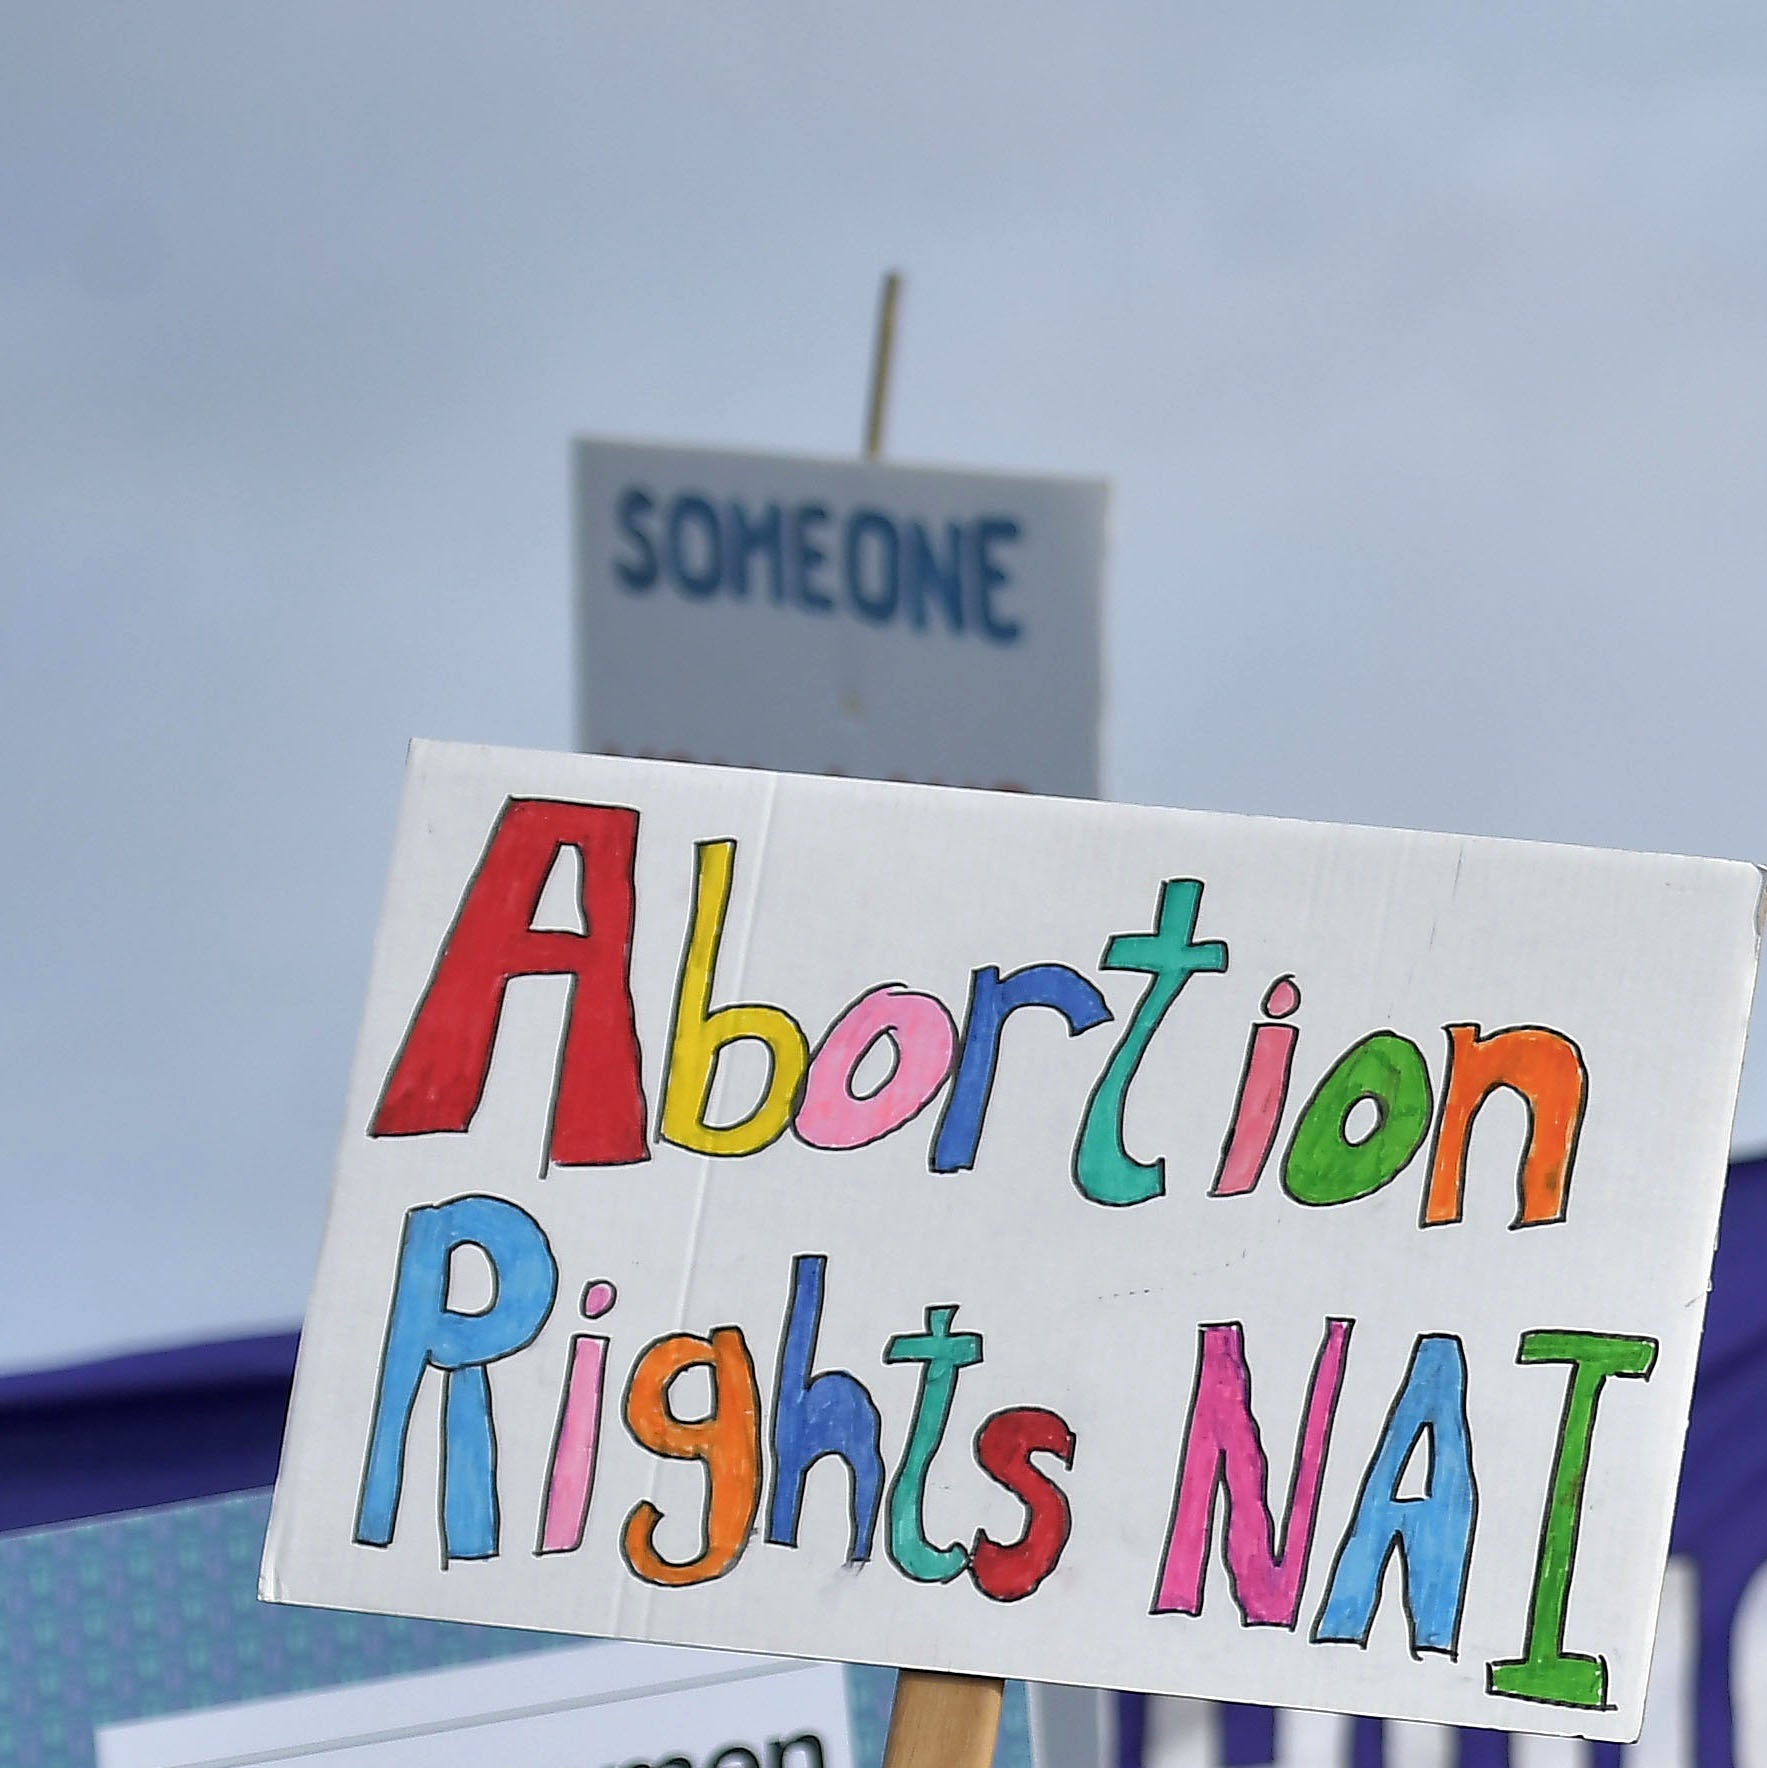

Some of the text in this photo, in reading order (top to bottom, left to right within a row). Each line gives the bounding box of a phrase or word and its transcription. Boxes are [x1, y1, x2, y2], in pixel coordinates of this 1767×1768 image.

[613, 486, 1024, 646] SOMEONE
[367, 796, 1589, 1230] Abortion
[353, 1192, 1660, 1712] Rights NAI
